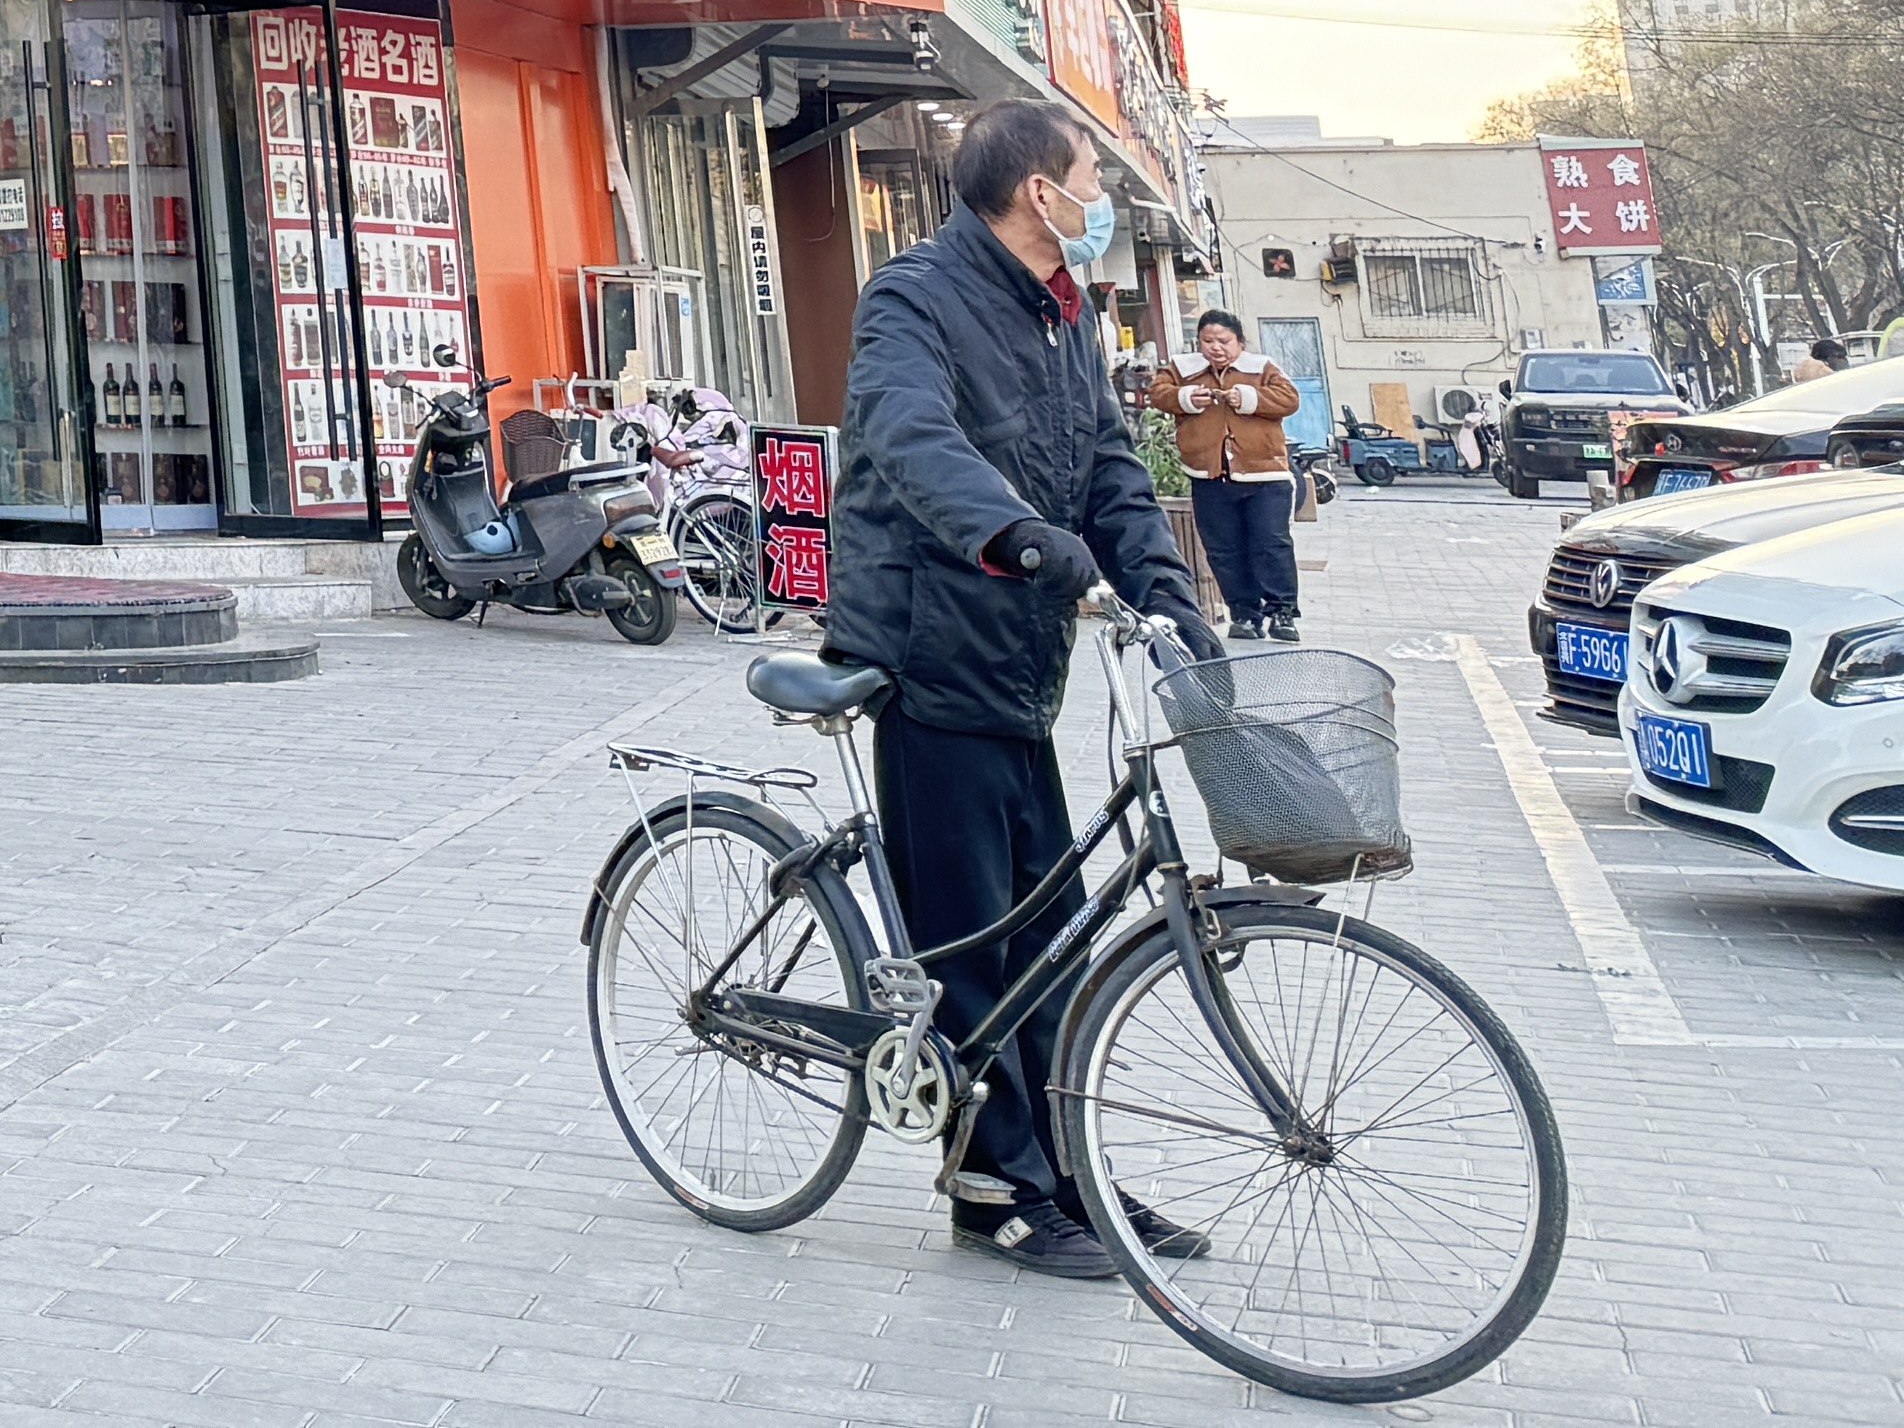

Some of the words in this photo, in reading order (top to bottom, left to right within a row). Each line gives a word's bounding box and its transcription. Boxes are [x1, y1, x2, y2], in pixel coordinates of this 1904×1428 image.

[1550, 154, 1641, 188] 熟食
[1558, 200, 1650, 234] 大饼
[758, 438, 828, 603] 烟酒
